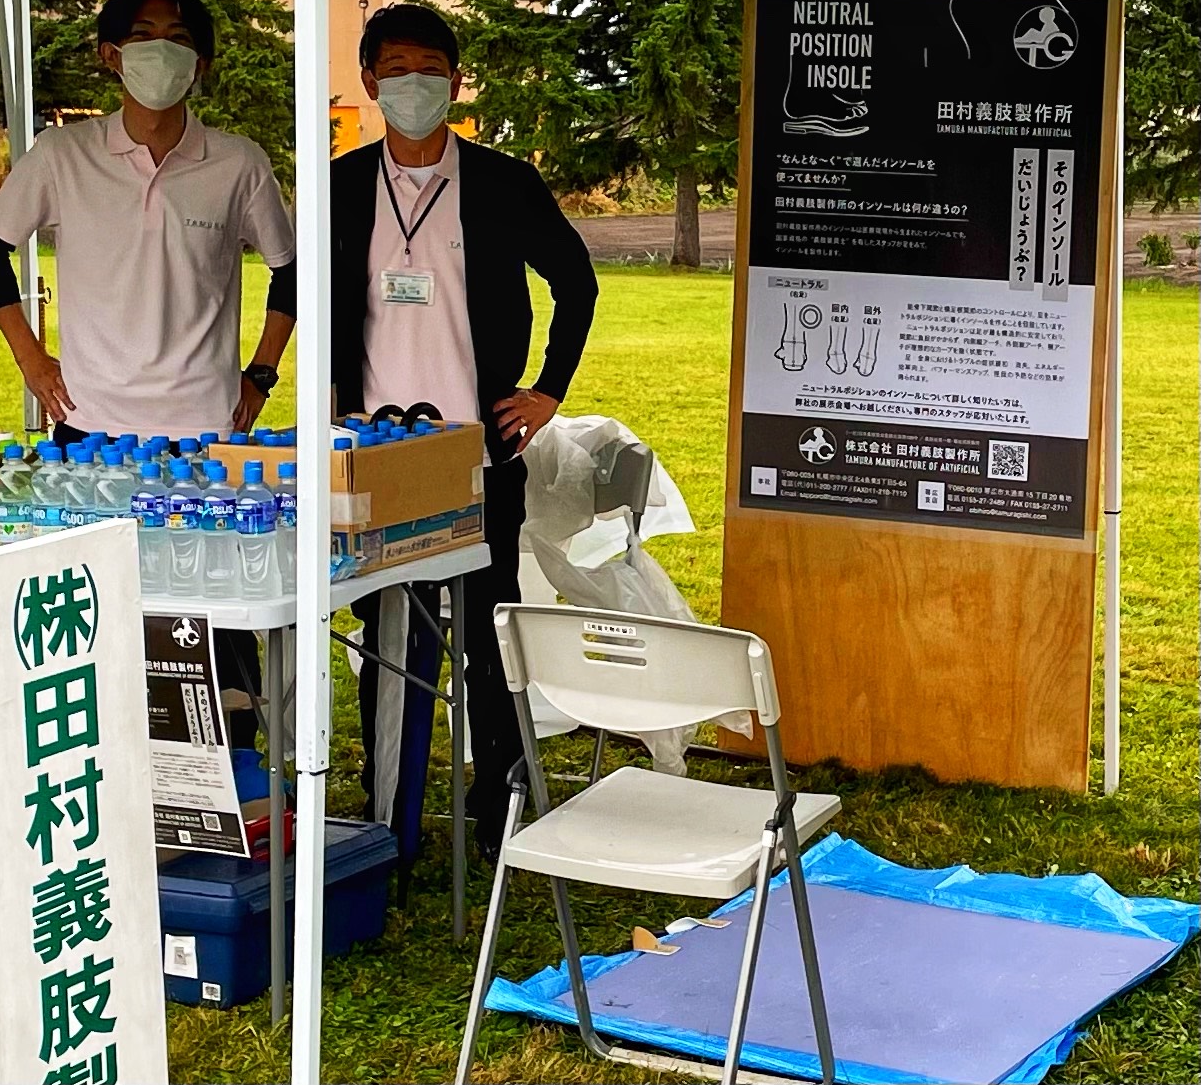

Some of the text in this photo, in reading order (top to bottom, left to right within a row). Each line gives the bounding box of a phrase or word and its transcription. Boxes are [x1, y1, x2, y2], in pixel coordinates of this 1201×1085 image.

[793, 0, 874, 26] NEUTRAL
[790, 32, 873, 58] POSITION
[807, 65, 872, 90] INSOLE
[937, 100, 1073, 124] 田村義肢製作所
[936, 123, 965, 134] TAMURA
[1020, 126, 1030, 136] OF
[1047, 160, 1068, 288] そのインソール
[775, 278, 824, 290] ニュートラル
[844, 439, 981, 462] 株式会社 田村義肢製作所
[844, 454, 980, 475] TAMURA MANUFACTURE OF ARTIFICIAL
